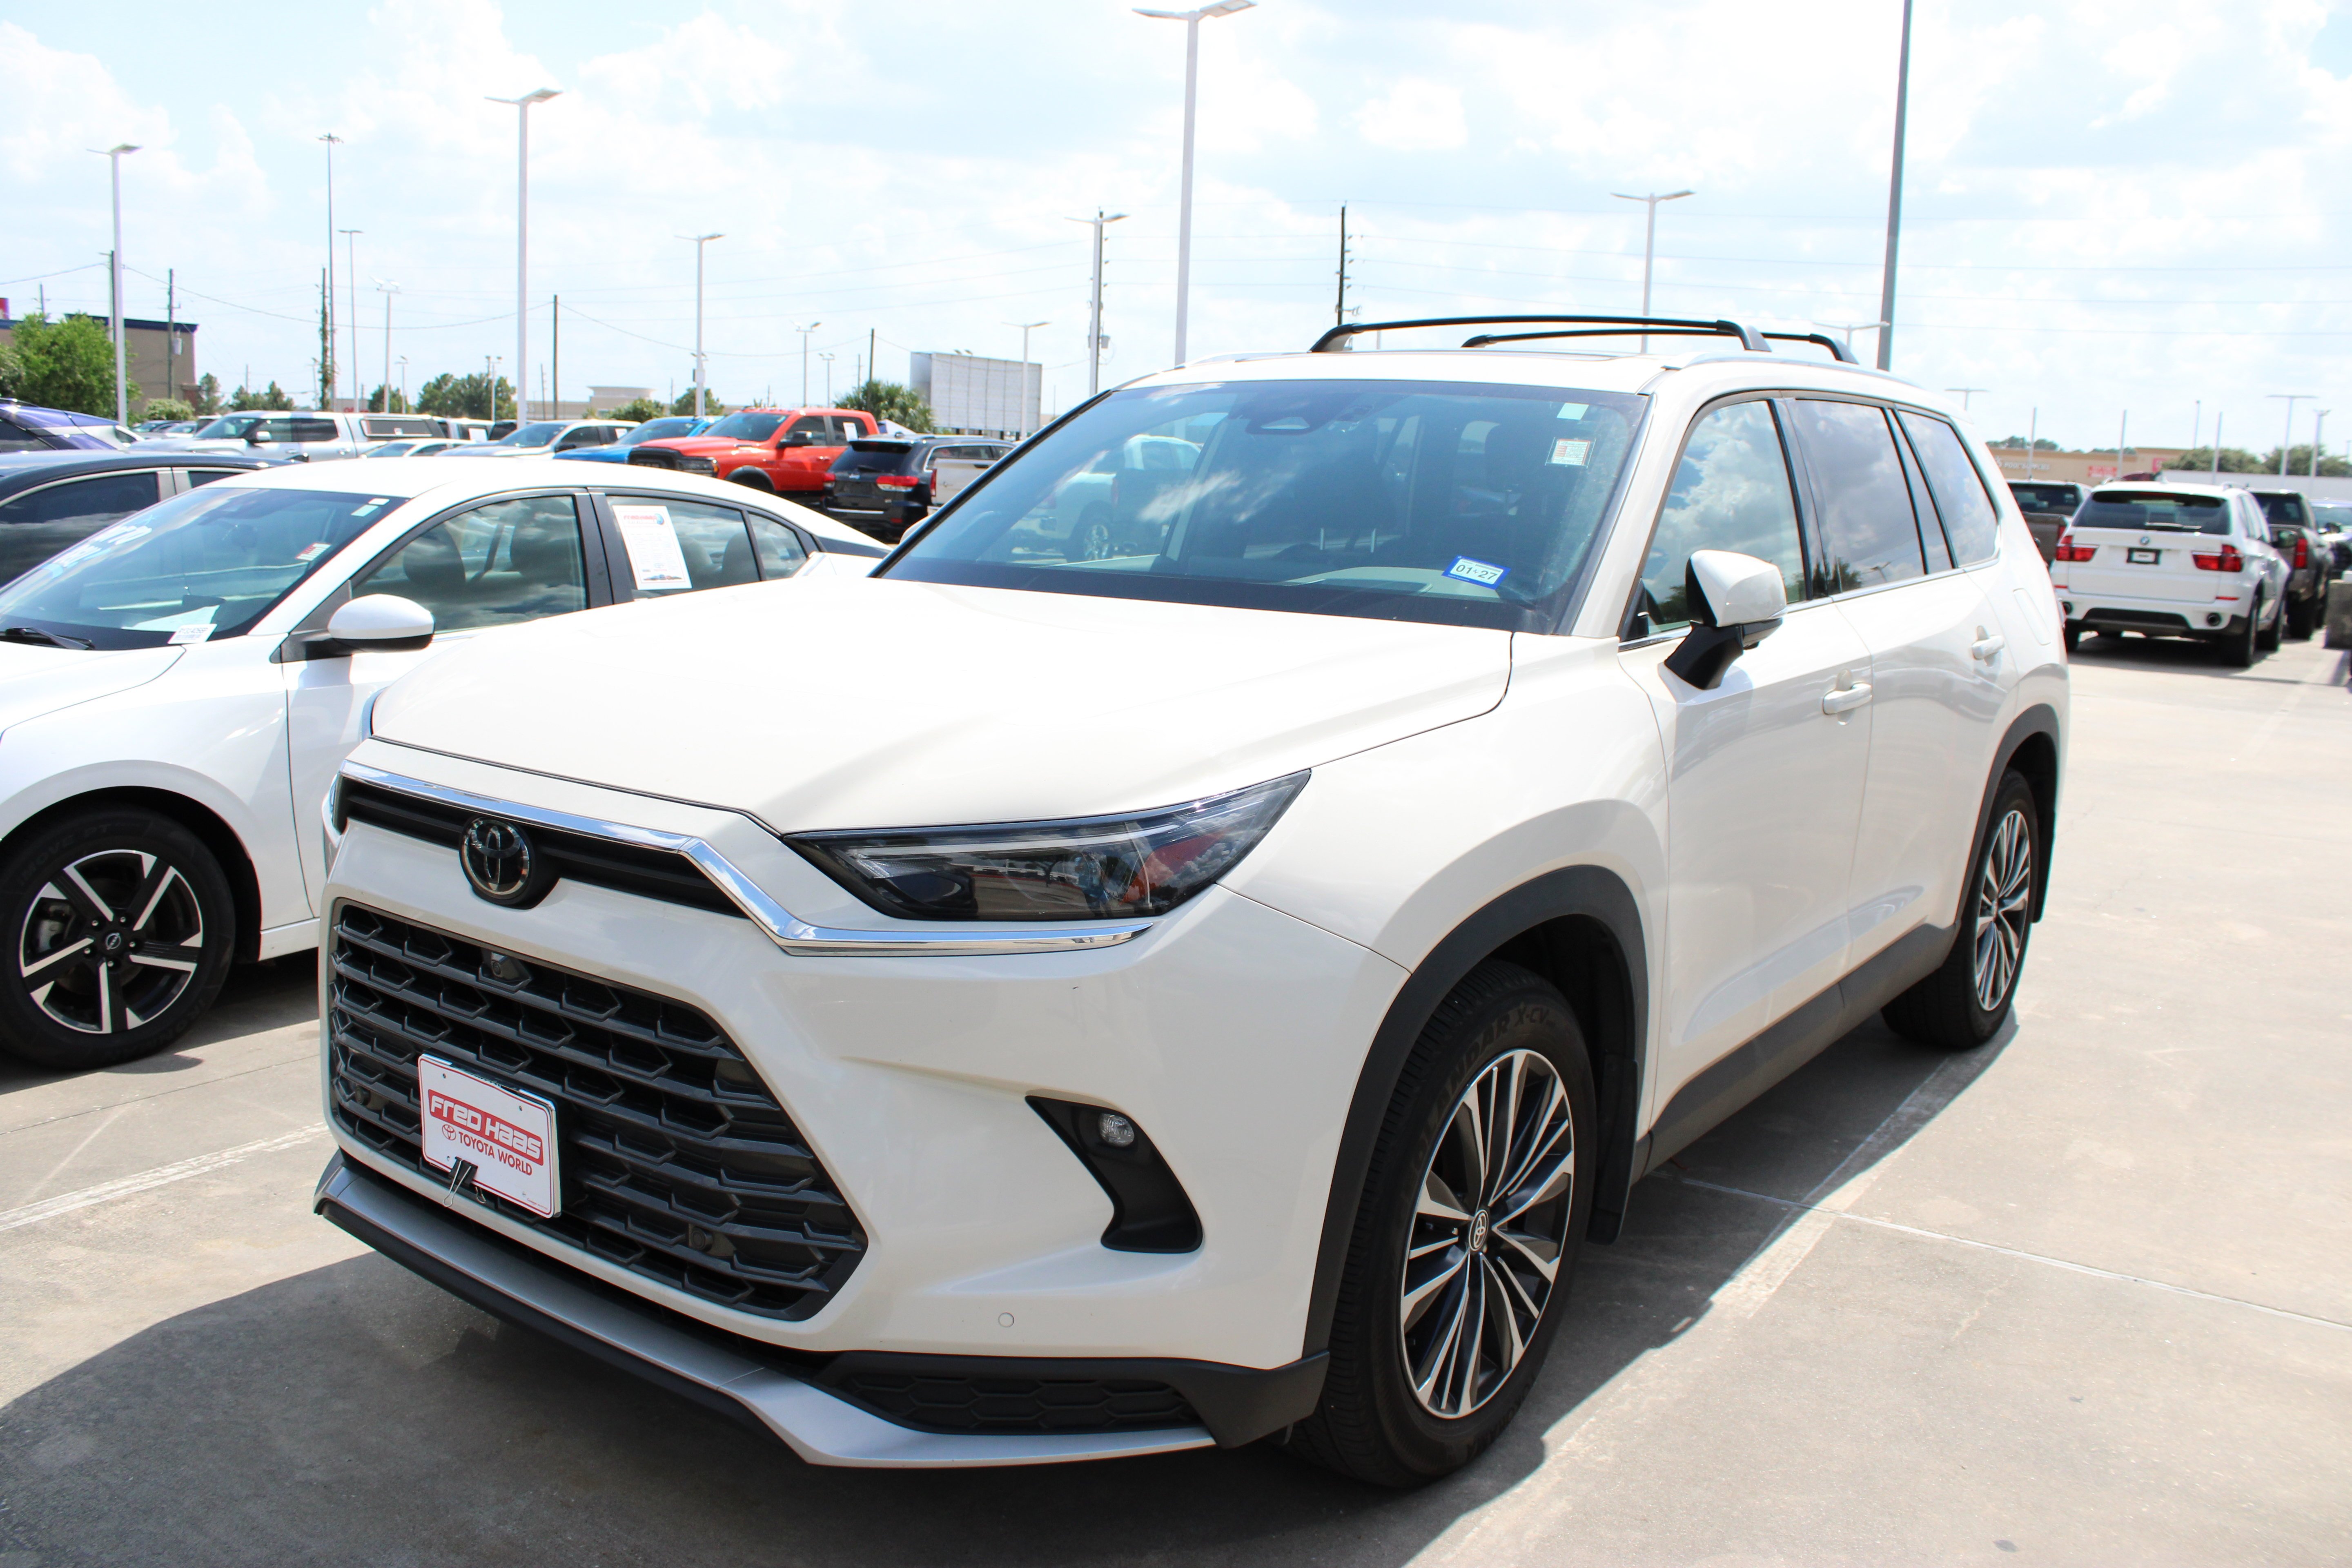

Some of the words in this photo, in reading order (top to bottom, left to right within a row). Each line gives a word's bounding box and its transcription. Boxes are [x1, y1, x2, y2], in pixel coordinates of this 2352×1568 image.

[1456, 564, 1473, 575] 01
[1478, 570, 1498, 580] 27
[459, 1131, 494, 1158] TOYOTA
[497, 1149, 532, 1176] WORLD
